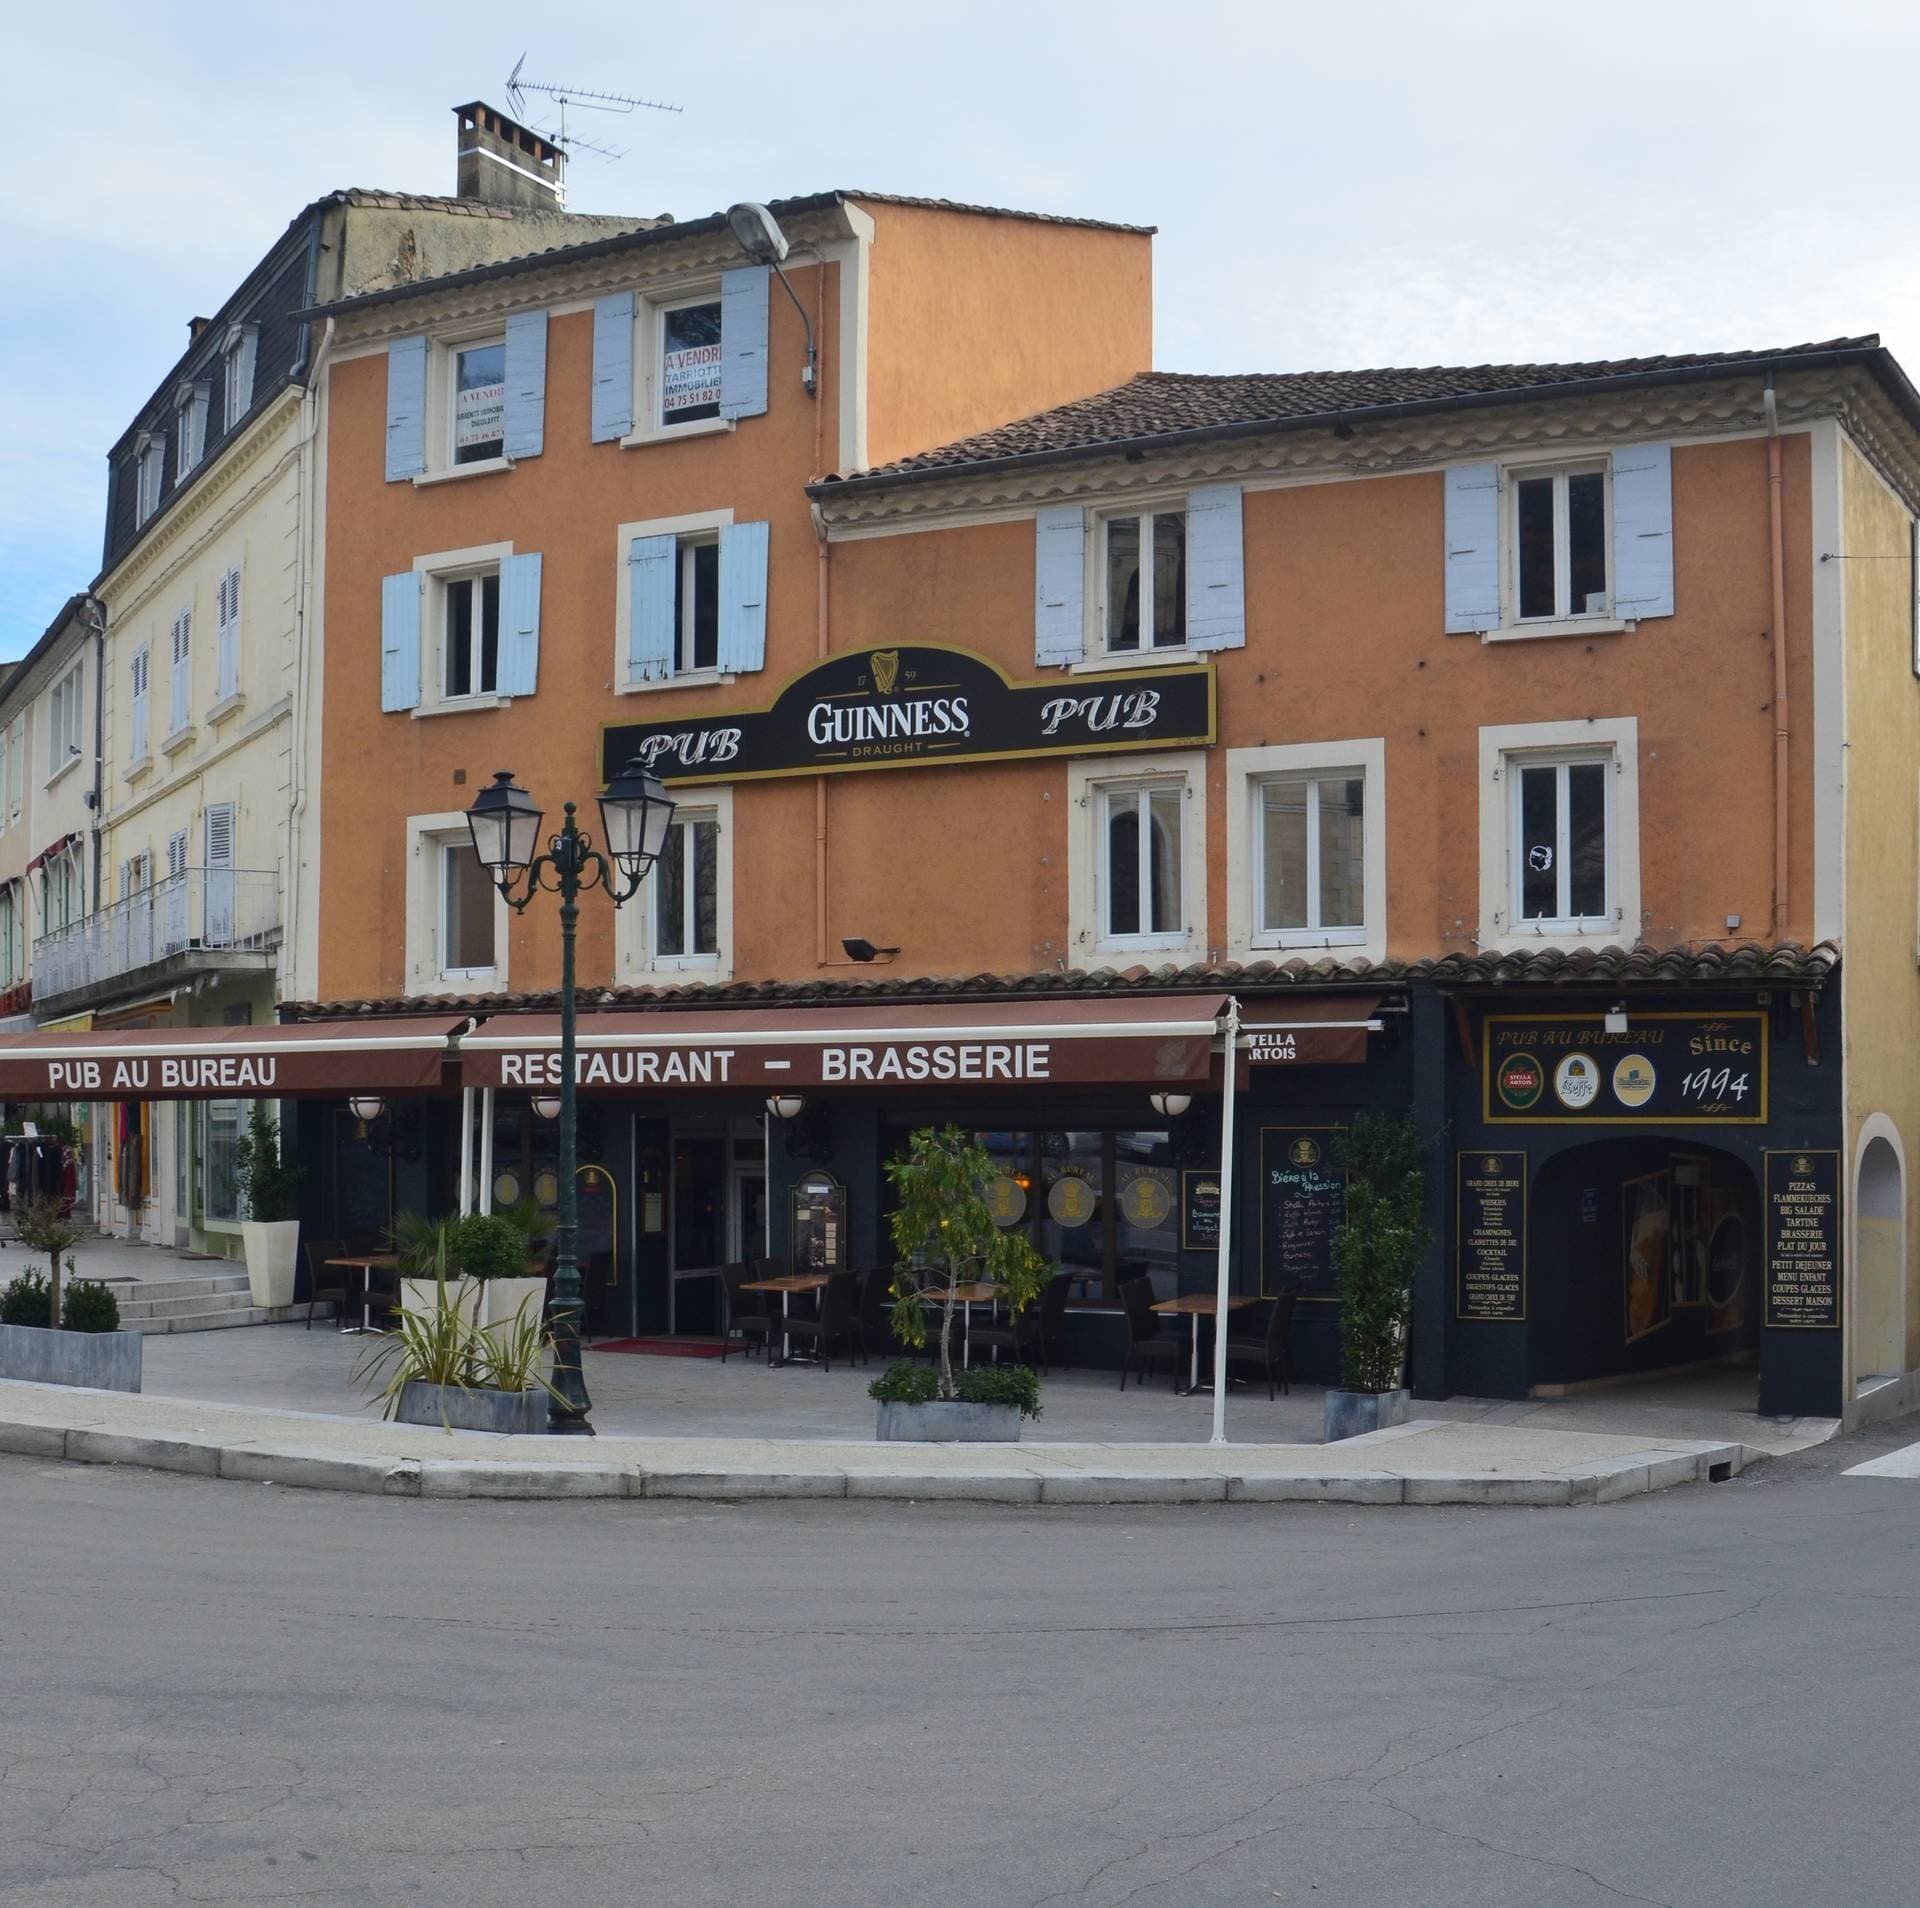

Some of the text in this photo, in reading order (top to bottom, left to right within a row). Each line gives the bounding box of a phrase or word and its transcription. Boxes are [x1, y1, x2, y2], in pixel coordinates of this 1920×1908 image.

[665, 346, 721, 370] A VENDR
[665, 365, 721, 383] TARRIOTT
[665, 377, 721, 395] IMMOBILIE
[1040, 690, 1161, 735] PUB
[807, 697, 970, 745] GUINNESS
[640, 727, 742, 768] PUB
[852, 741, 923, 757] DRAUGHT
[1248, 1033, 1296, 1046] TELLA
[1497, 1029, 1666, 1046] PUB AU BUREAU
[1690, 1034, 1752, 1056] Since
[1248, 1047, 1296, 1060] RTOIS
[501, 1050, 735, 1085] RESTAURANT
[821, 1044, 1051, 1081] BRASSERIE
[48, 1057, 276, 1089] PUB AU BUREAU
[1682, 1066, 1751, 1101] 1994
[1788, 1182, 1816, 1191] PIZZAS
[1780, 1206, 1824, 1215] BIG SALADE
[1786, 1217, 1819, 1227] TARTINE
[1781, 1229, 1824, 1239] BRASSERIE
[1777, 1241, 1827, 1252] PLAT DU JOUR
[1772, 1260, 1832, 1271] PETIT DEJEUNER
[1777, 1272, 1827, 1282] MENU ENFANT
[1772, 1284, 1800, 1293] COUPES
[1773, 1296, 1832, 1306] DESSERT MAISON
